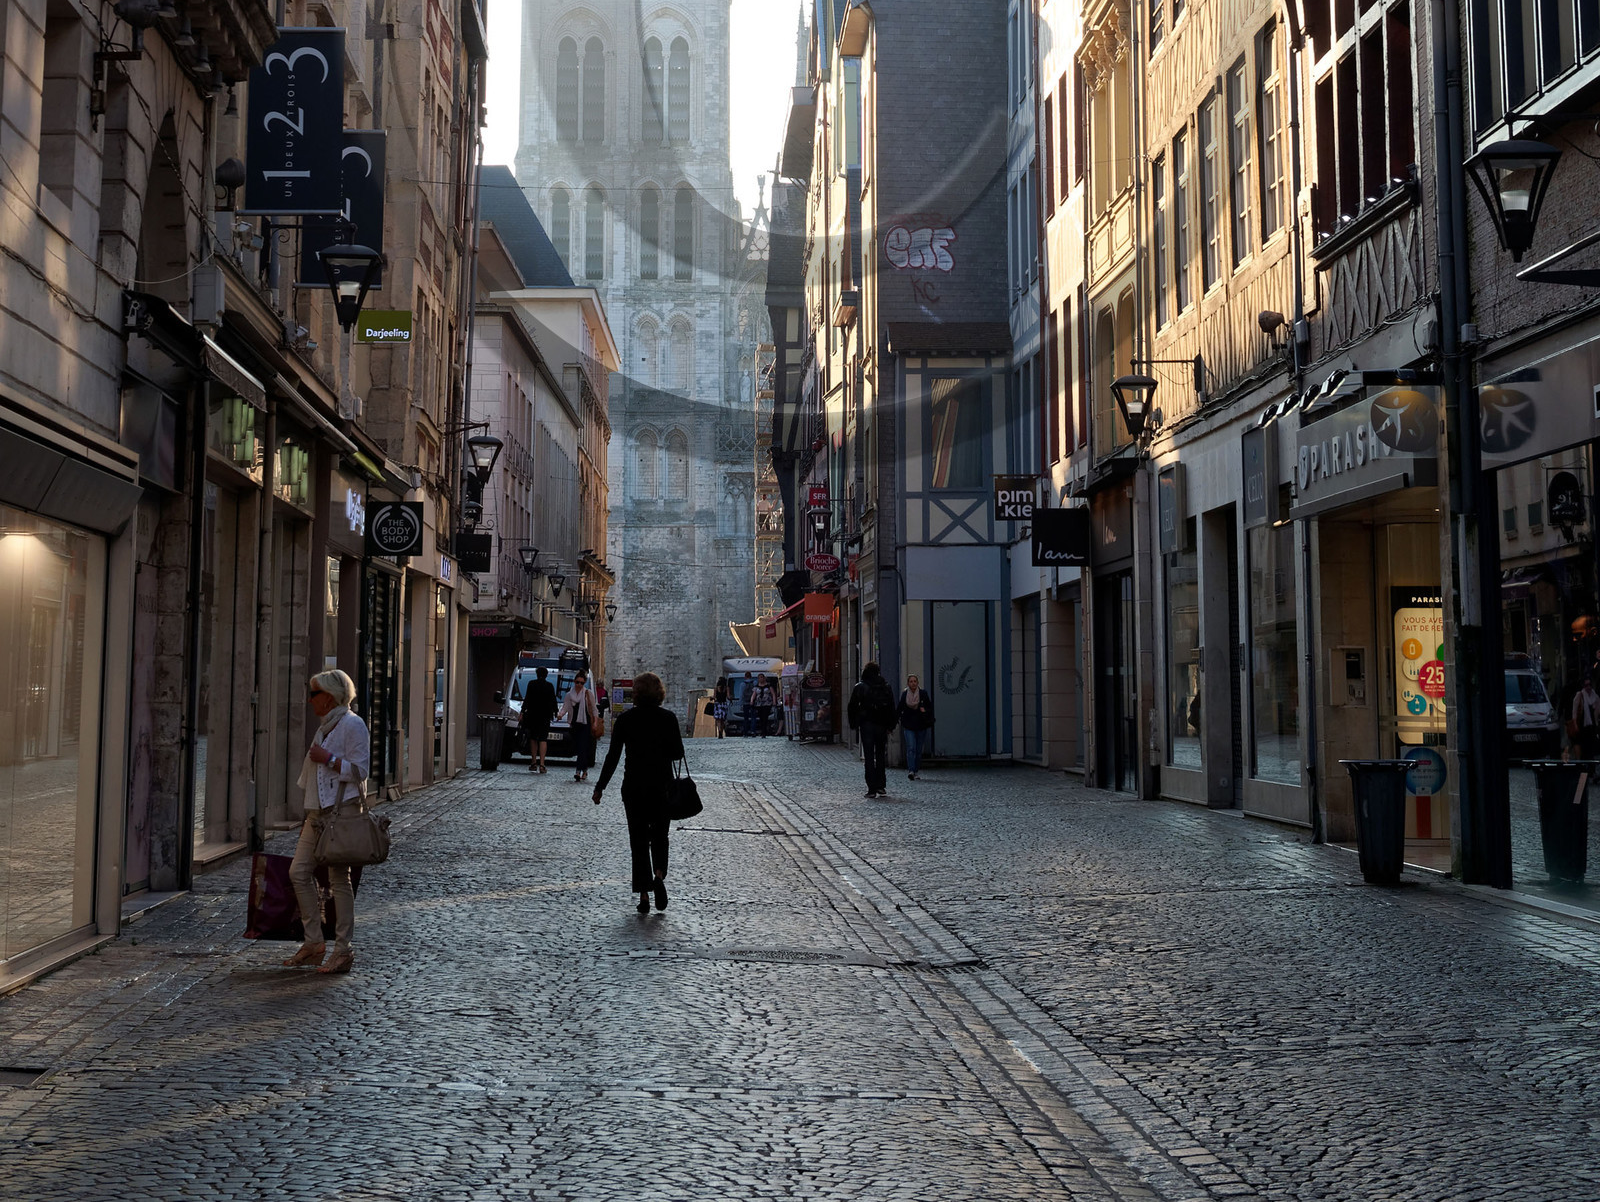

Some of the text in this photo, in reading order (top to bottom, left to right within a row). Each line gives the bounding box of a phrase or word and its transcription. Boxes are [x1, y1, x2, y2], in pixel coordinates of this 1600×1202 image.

[284, 74, 296, 198] UN DEUX TROIS
[366, 328, 409, 339] Darjeeling
[998, 489, 1033, 506] pim
[381, 527, 411, 535] BODY
[383, 535, 409, 543] SHOP
[810, 556, 837, 564] Brioche
[805, 614, 830, 622] orange
[1420, 624, 1429, 632] DE
[472, 628, 498, 637] SHOP
